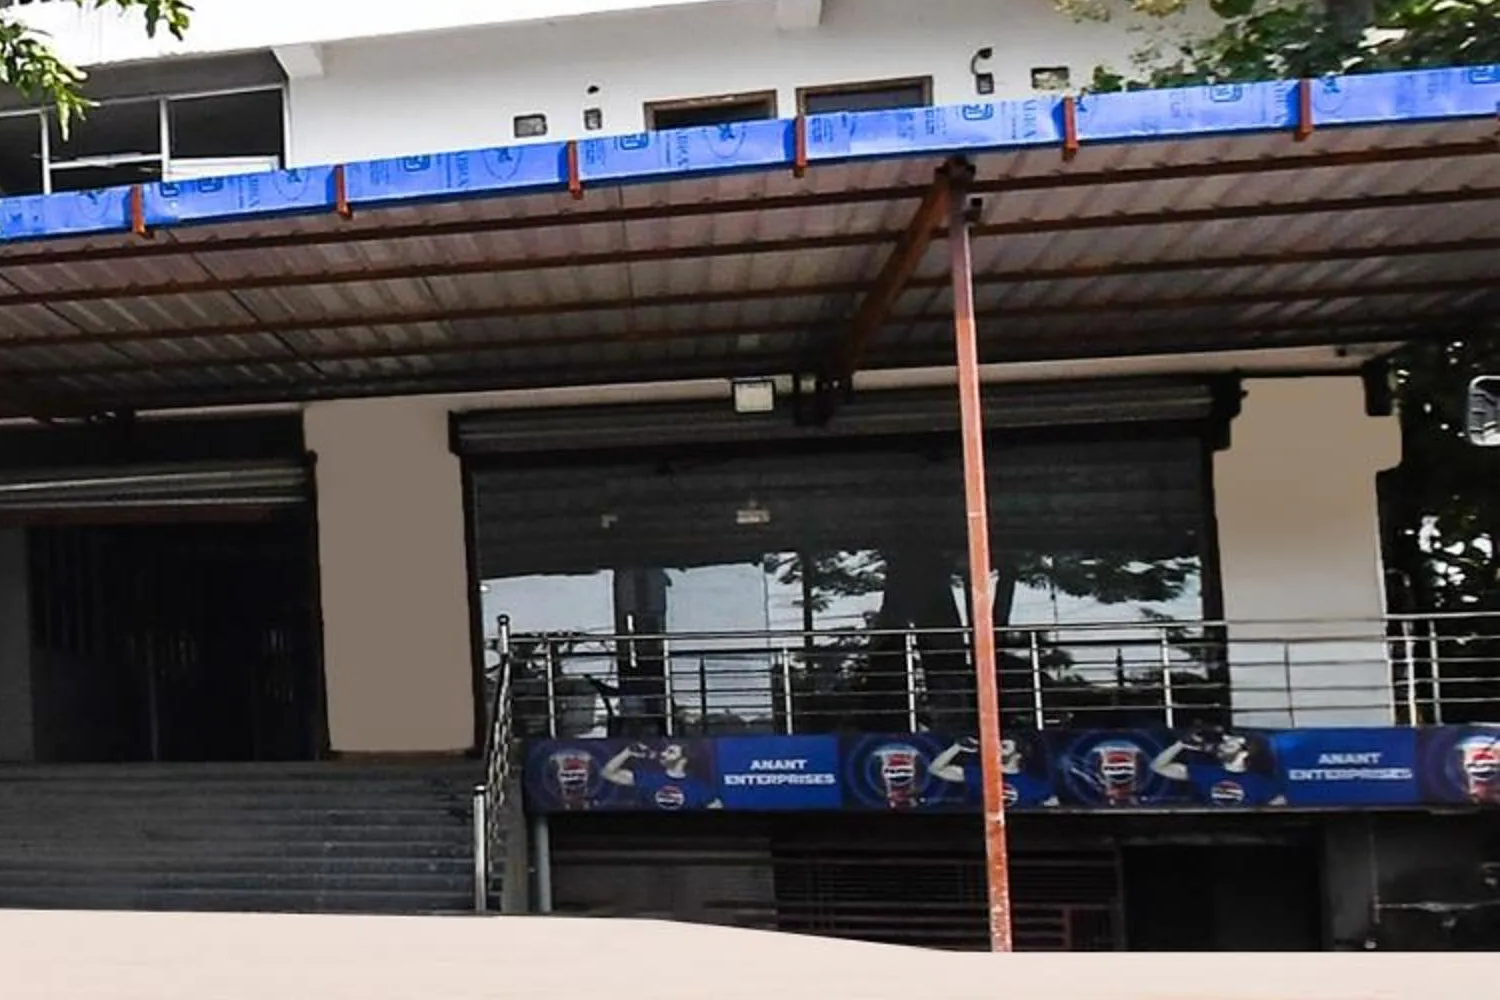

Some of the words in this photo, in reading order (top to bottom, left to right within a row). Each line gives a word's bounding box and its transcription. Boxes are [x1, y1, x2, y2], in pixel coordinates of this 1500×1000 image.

[1318, 752, 1381, 765] ANANT
[750, 759, 808, 771] ANANT
[724, 773, 836, 785] ENTERPRISES
[1289, 768, 1413, 781] ENTERPRISES
